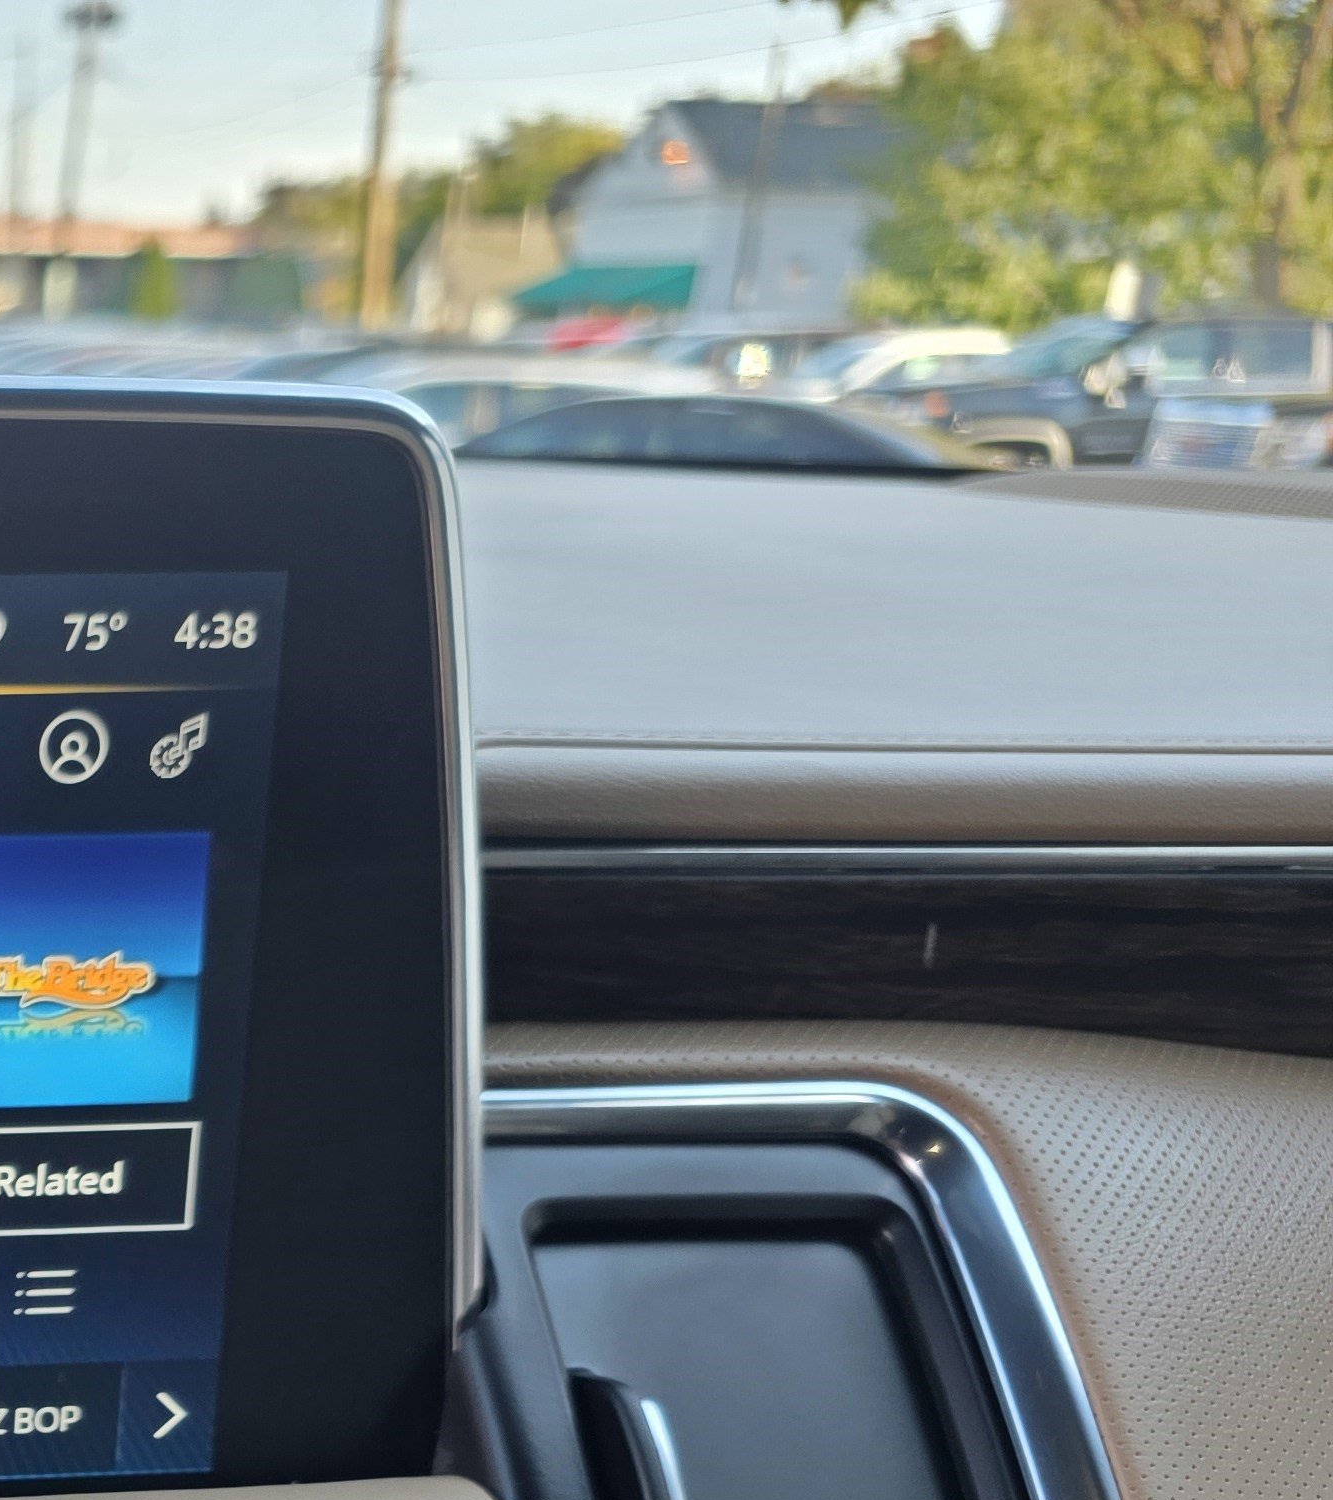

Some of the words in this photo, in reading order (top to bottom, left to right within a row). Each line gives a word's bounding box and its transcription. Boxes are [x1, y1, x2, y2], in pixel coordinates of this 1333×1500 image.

[173, 611, 258, 650] 4:38
[35, 950, 157, 1009] Bridge
[13, 1404, 83, 1436] BOP
